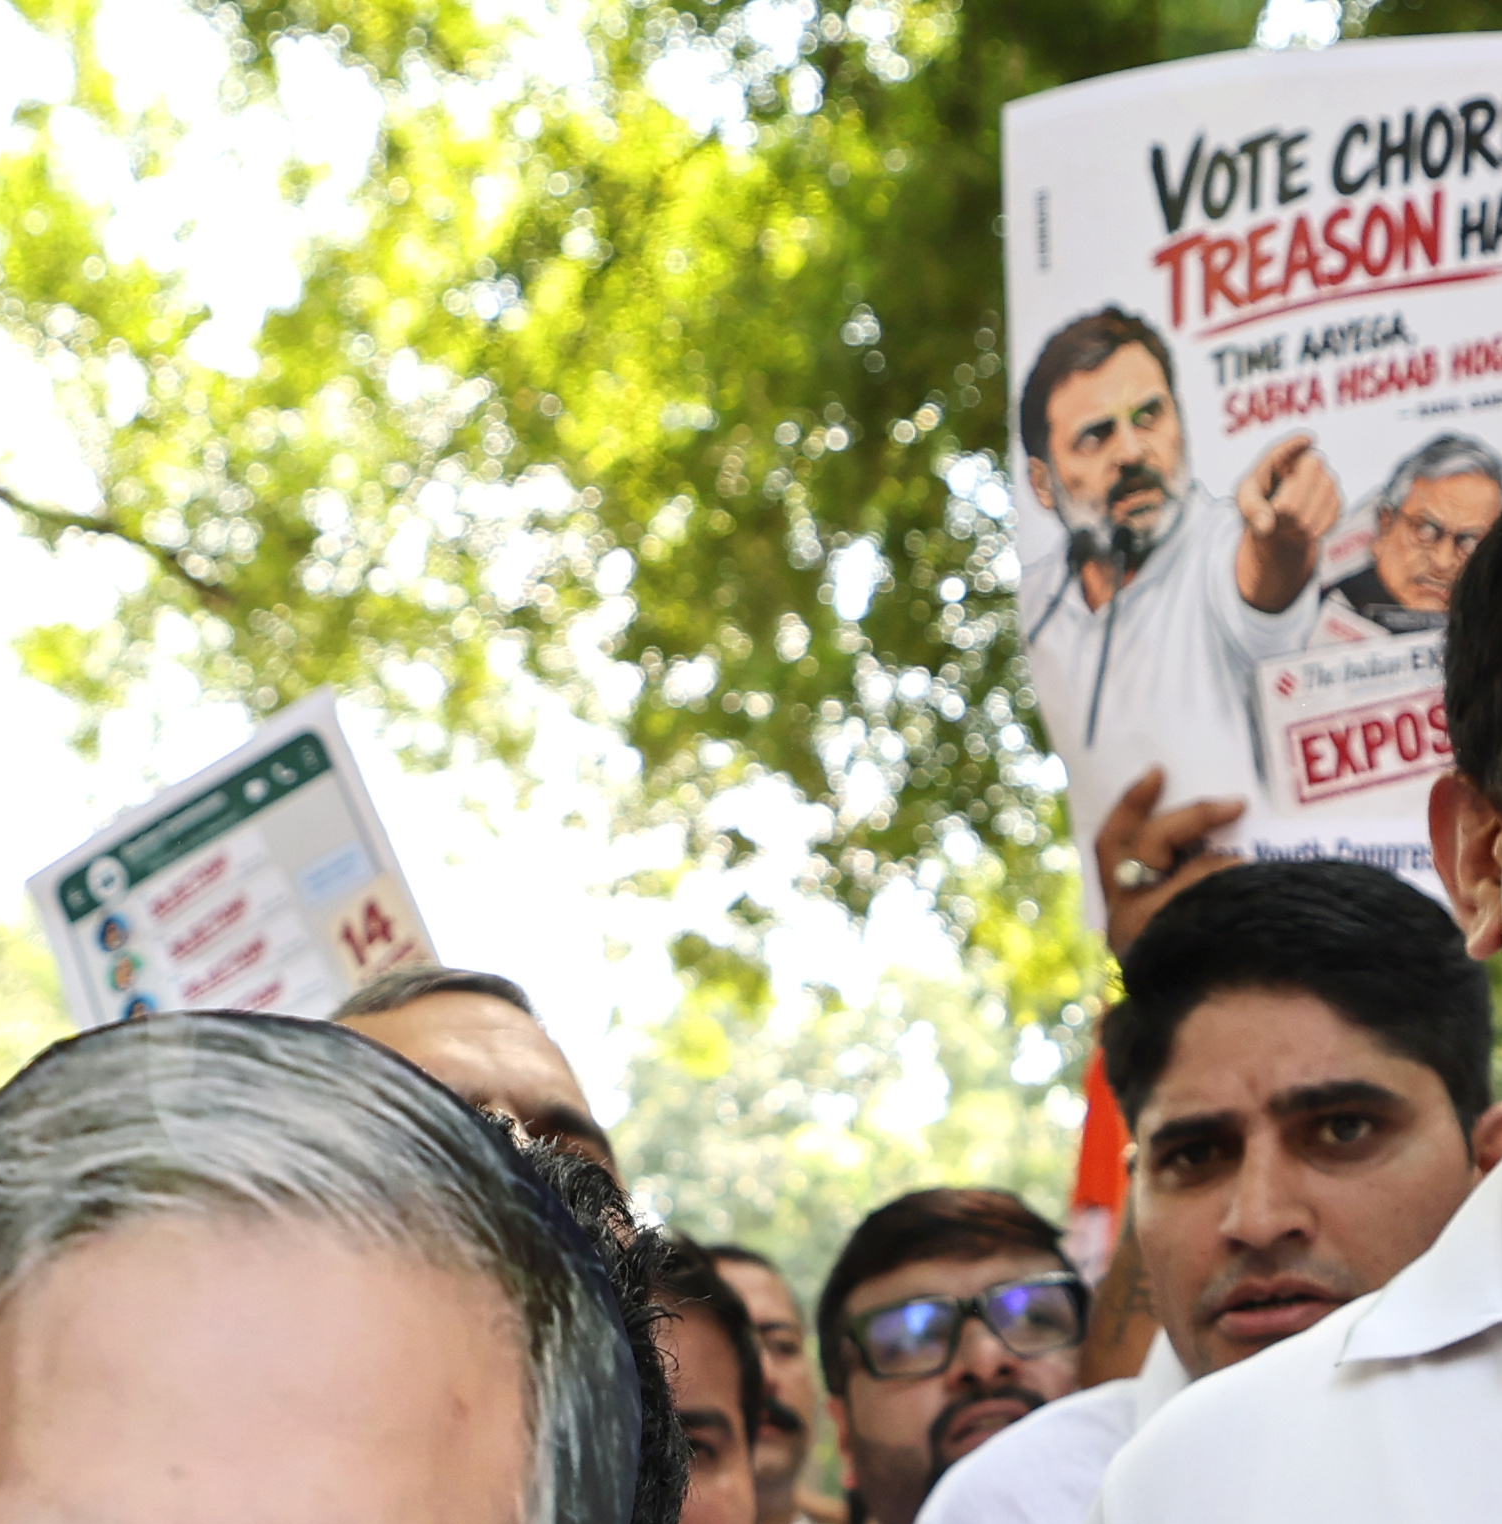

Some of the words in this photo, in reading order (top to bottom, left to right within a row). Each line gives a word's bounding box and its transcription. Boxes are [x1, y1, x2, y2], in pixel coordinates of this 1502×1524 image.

[1151, 130, 1311, 233] VOTE
[1154, 189, 1446, 329] TREASON
[1211, 337, 1285, 386] TIME
[1225, 374, 1325, 435] SABKA
[1336, 346, 1438, 403] HISAAB
